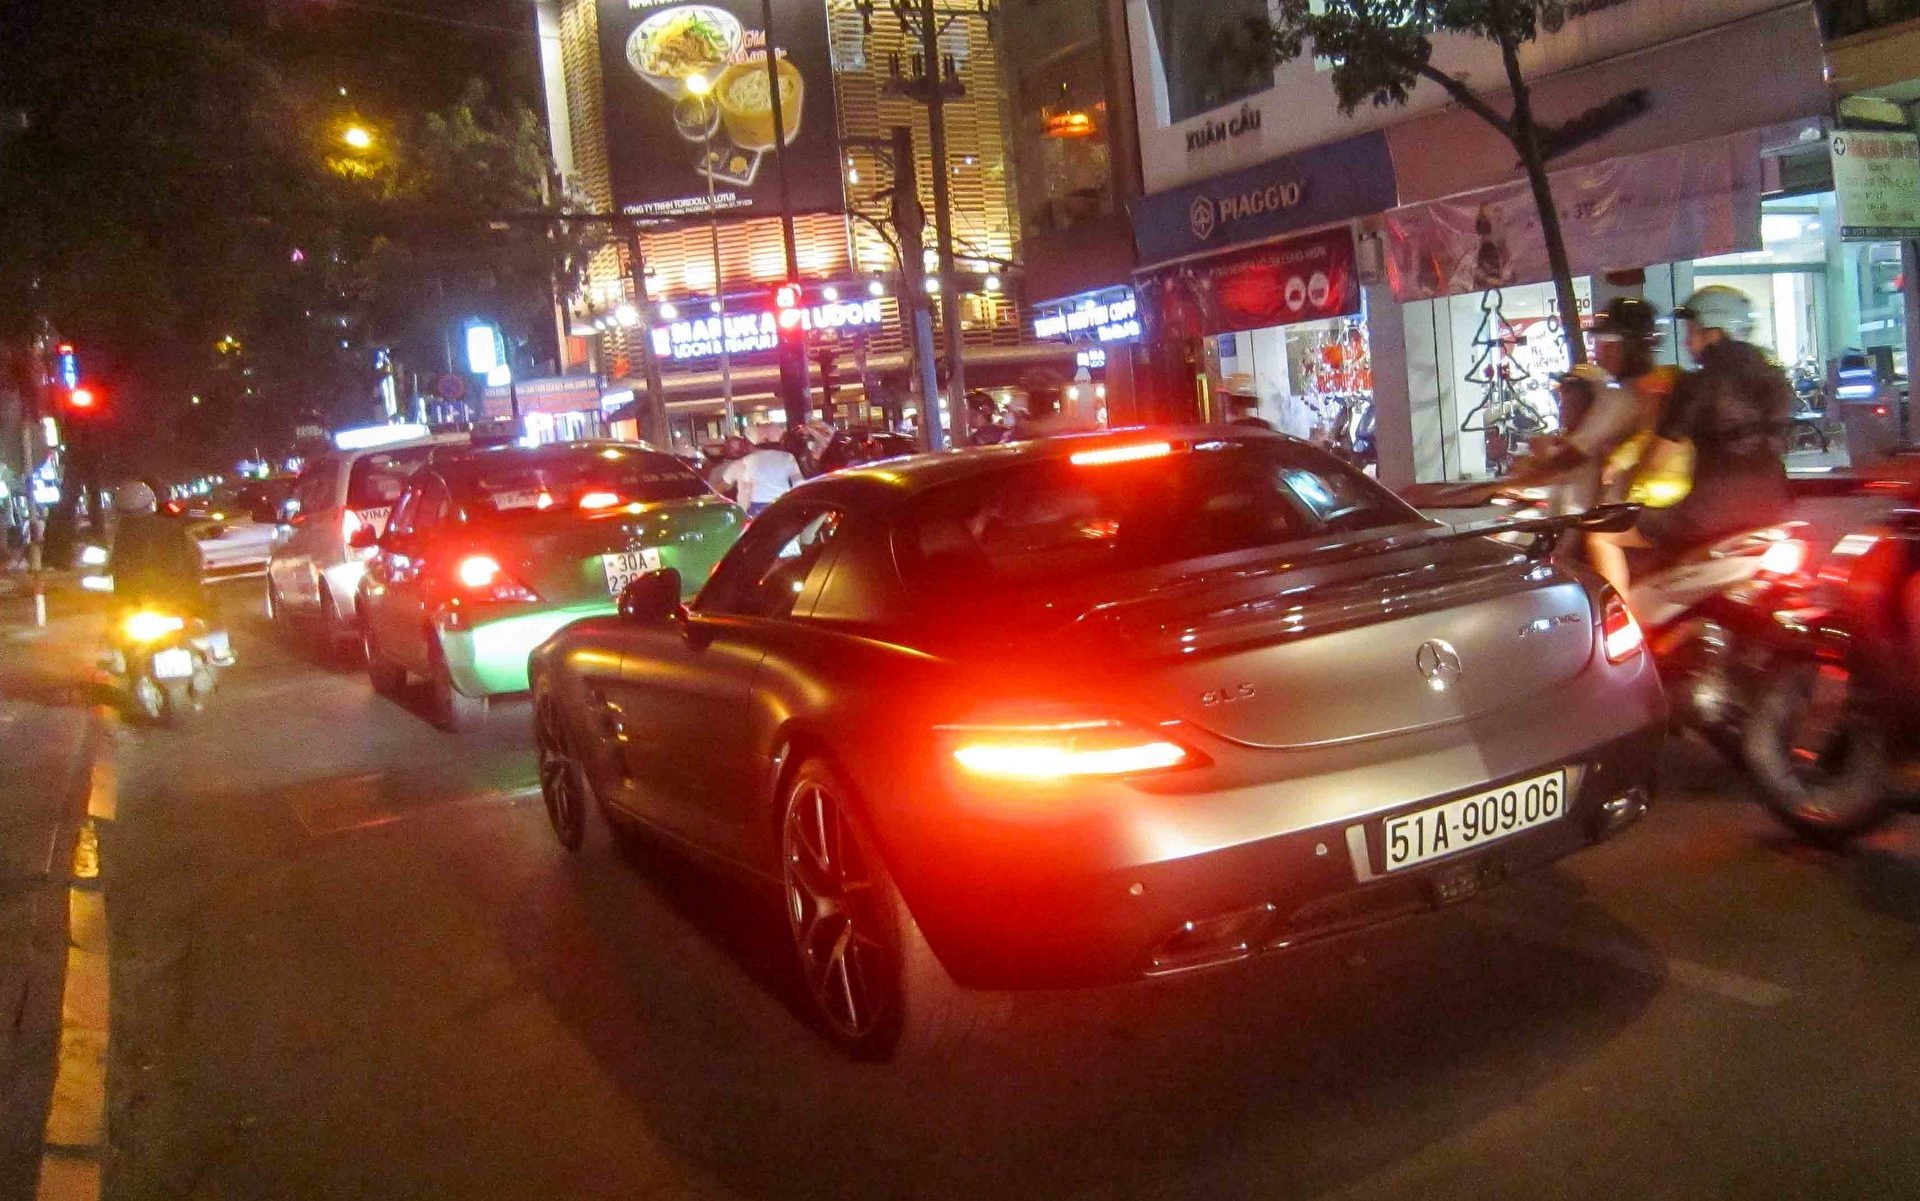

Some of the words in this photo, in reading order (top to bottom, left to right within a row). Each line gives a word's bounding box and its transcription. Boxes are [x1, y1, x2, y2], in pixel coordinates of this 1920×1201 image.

[1220, 182, 1300, 222] PIAGGIO
[813, 299, 881, 329] UDON
[618, 552, 648, 572] 30A
[1391, 778, 1559, 863] 51A-909.06
